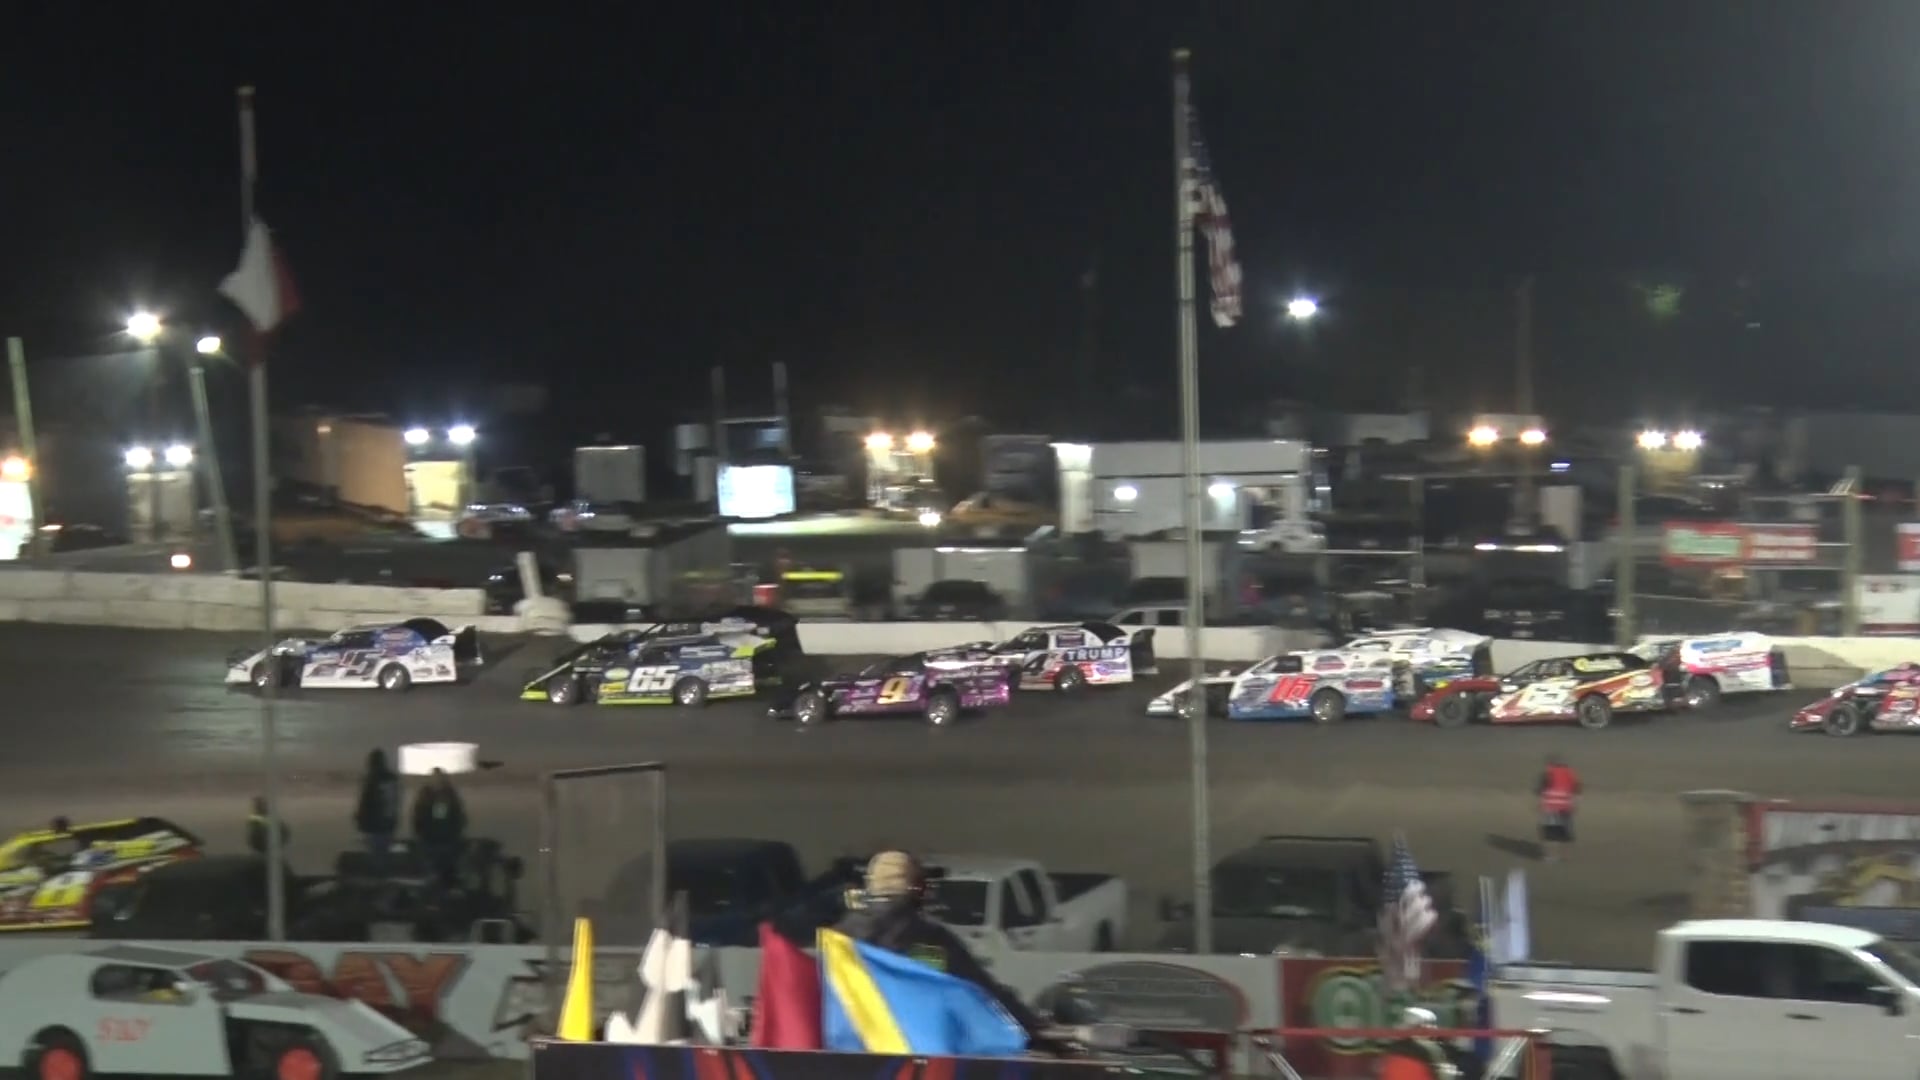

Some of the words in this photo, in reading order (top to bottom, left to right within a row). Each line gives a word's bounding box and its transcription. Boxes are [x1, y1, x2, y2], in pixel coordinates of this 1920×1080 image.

[1066, 648, 1127, 661] TRUMP
[627, 665, 681, 694] 65
[876, 676, 908, 704] 9
